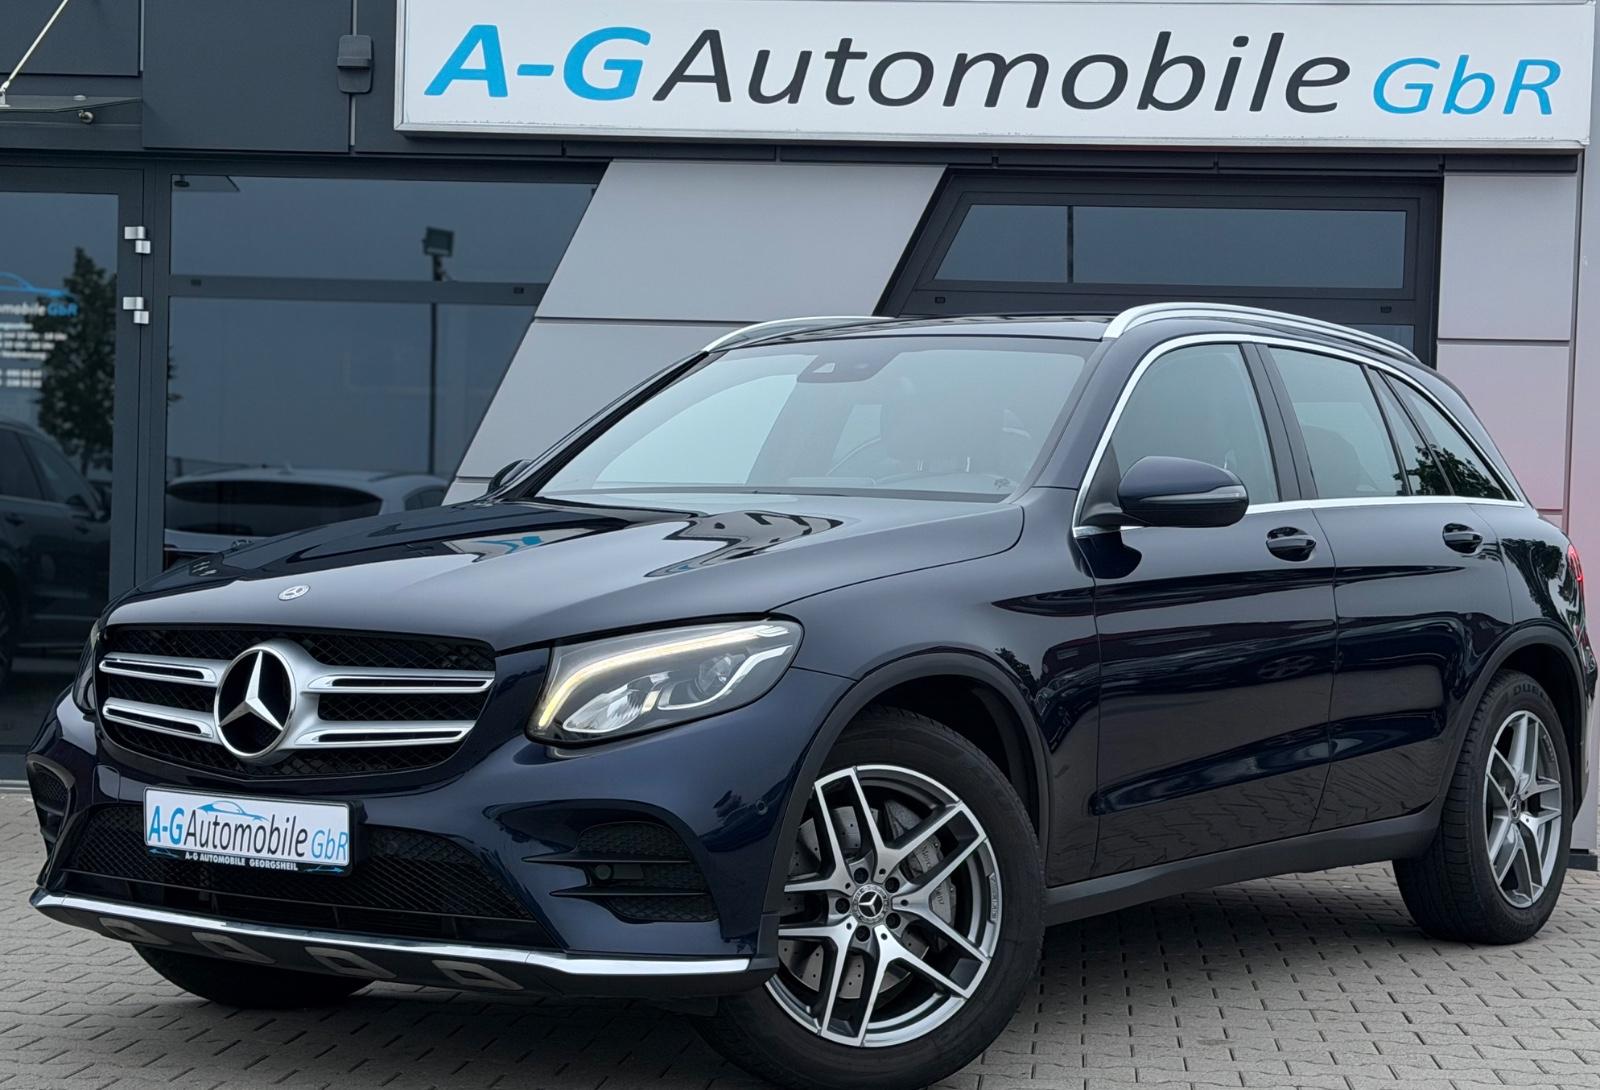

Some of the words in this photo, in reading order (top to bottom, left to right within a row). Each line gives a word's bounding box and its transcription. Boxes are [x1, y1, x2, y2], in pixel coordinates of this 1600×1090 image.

[1372, 54, 1561, 116] GbR
[311, 827, 349, 860] GbR
[185, 851, 199, 862] A-G
[200, 853, 246, 866] AUTOMOBILE
[249, 858, 298, 871] GEORGSHEIL
